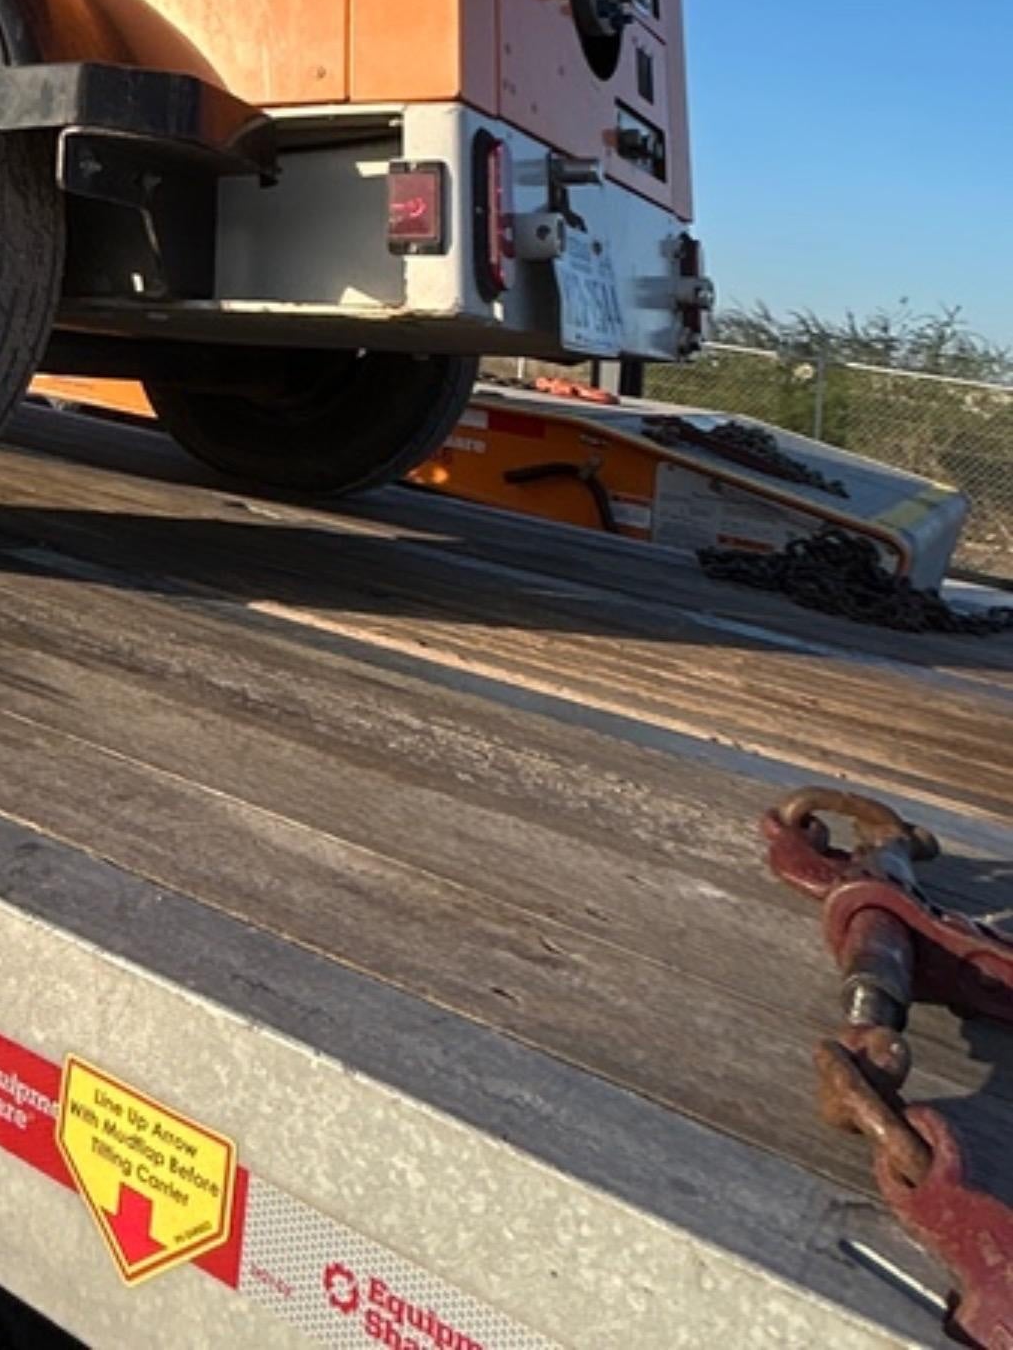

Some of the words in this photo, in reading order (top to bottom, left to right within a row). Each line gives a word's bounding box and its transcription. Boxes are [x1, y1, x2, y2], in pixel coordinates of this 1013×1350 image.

[70, 1100, 100, 1130] With
[103, 1119, 165, 1168] Mudflap
[169, 1156, 220, 1198] Before
[94, 1088, 123, 1117] Line
[127, 1106, 149, 1132] Up
[151, 1122, 198, 1158] Arrow
[136, 1163, 190, 1207] Carrier
